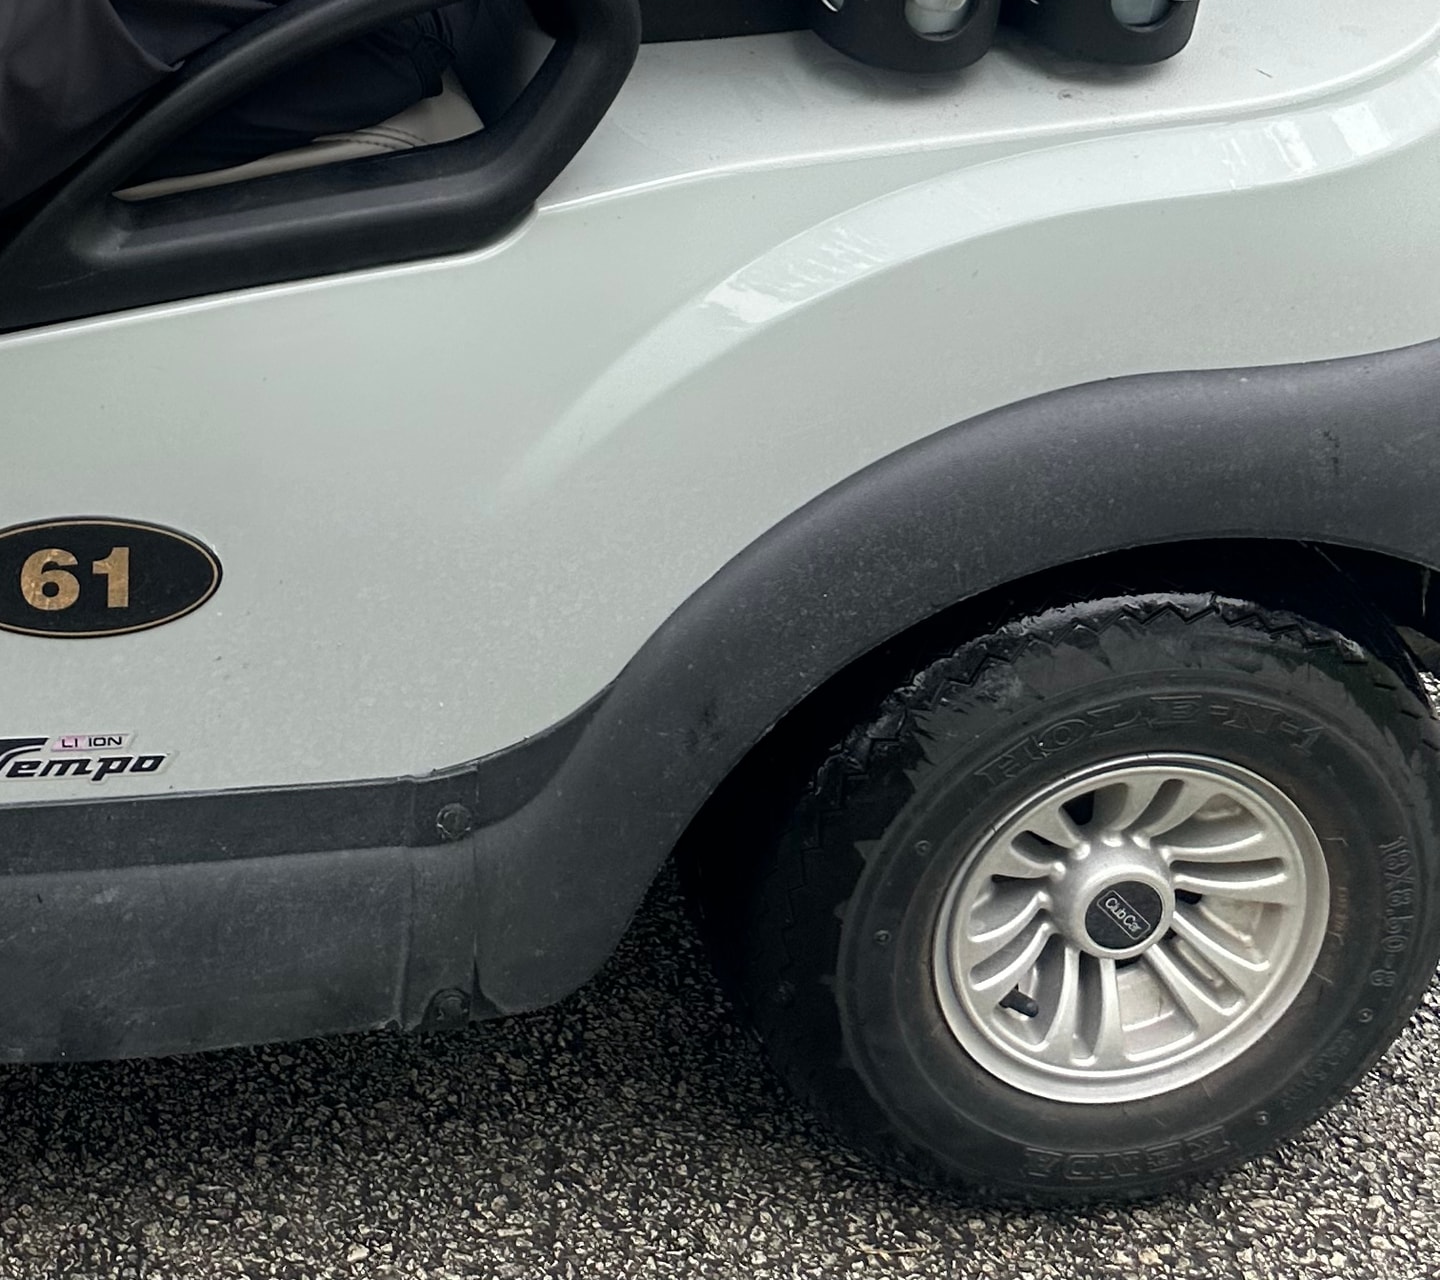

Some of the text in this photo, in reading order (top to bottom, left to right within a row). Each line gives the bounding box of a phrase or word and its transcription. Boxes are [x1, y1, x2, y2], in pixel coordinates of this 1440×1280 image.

[19, 546, 130, 611] 61
[60, 735, 123, 748] LI ION
[1105, 897, 1141, 932] Club Car
